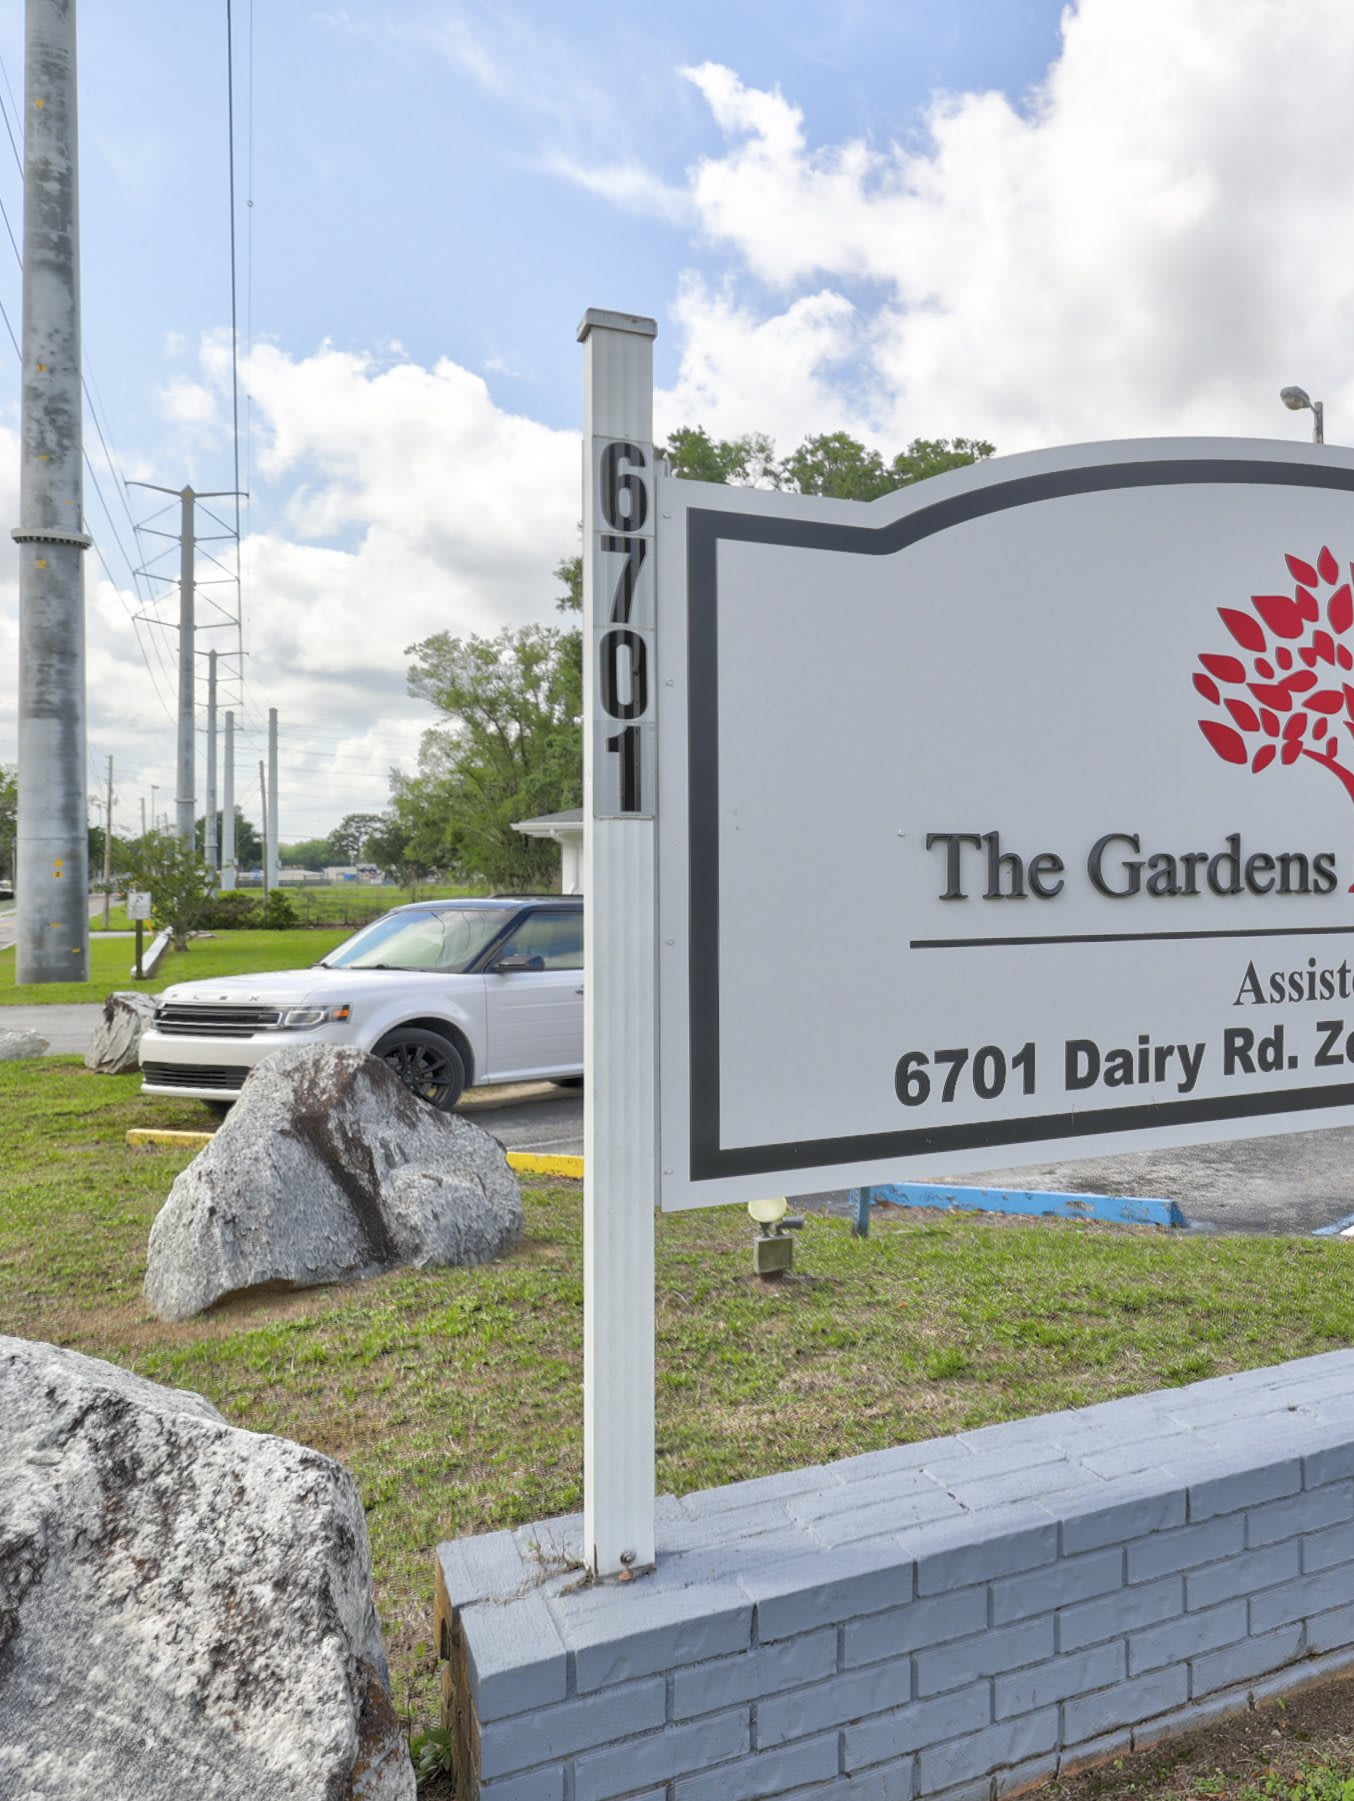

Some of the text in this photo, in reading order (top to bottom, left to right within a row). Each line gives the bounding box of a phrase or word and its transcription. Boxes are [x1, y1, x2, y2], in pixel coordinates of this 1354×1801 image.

[600, 442, 648, 812] 6701
[926, 831, 1064, 901] The
[1087, 833, 1338, 898] Gardens
[895, 1042, 1036, 1107] 6701
[1065, 1034, 1206, 1094] Dairy
[1223, 1022, 1298, 1076] Rd.
